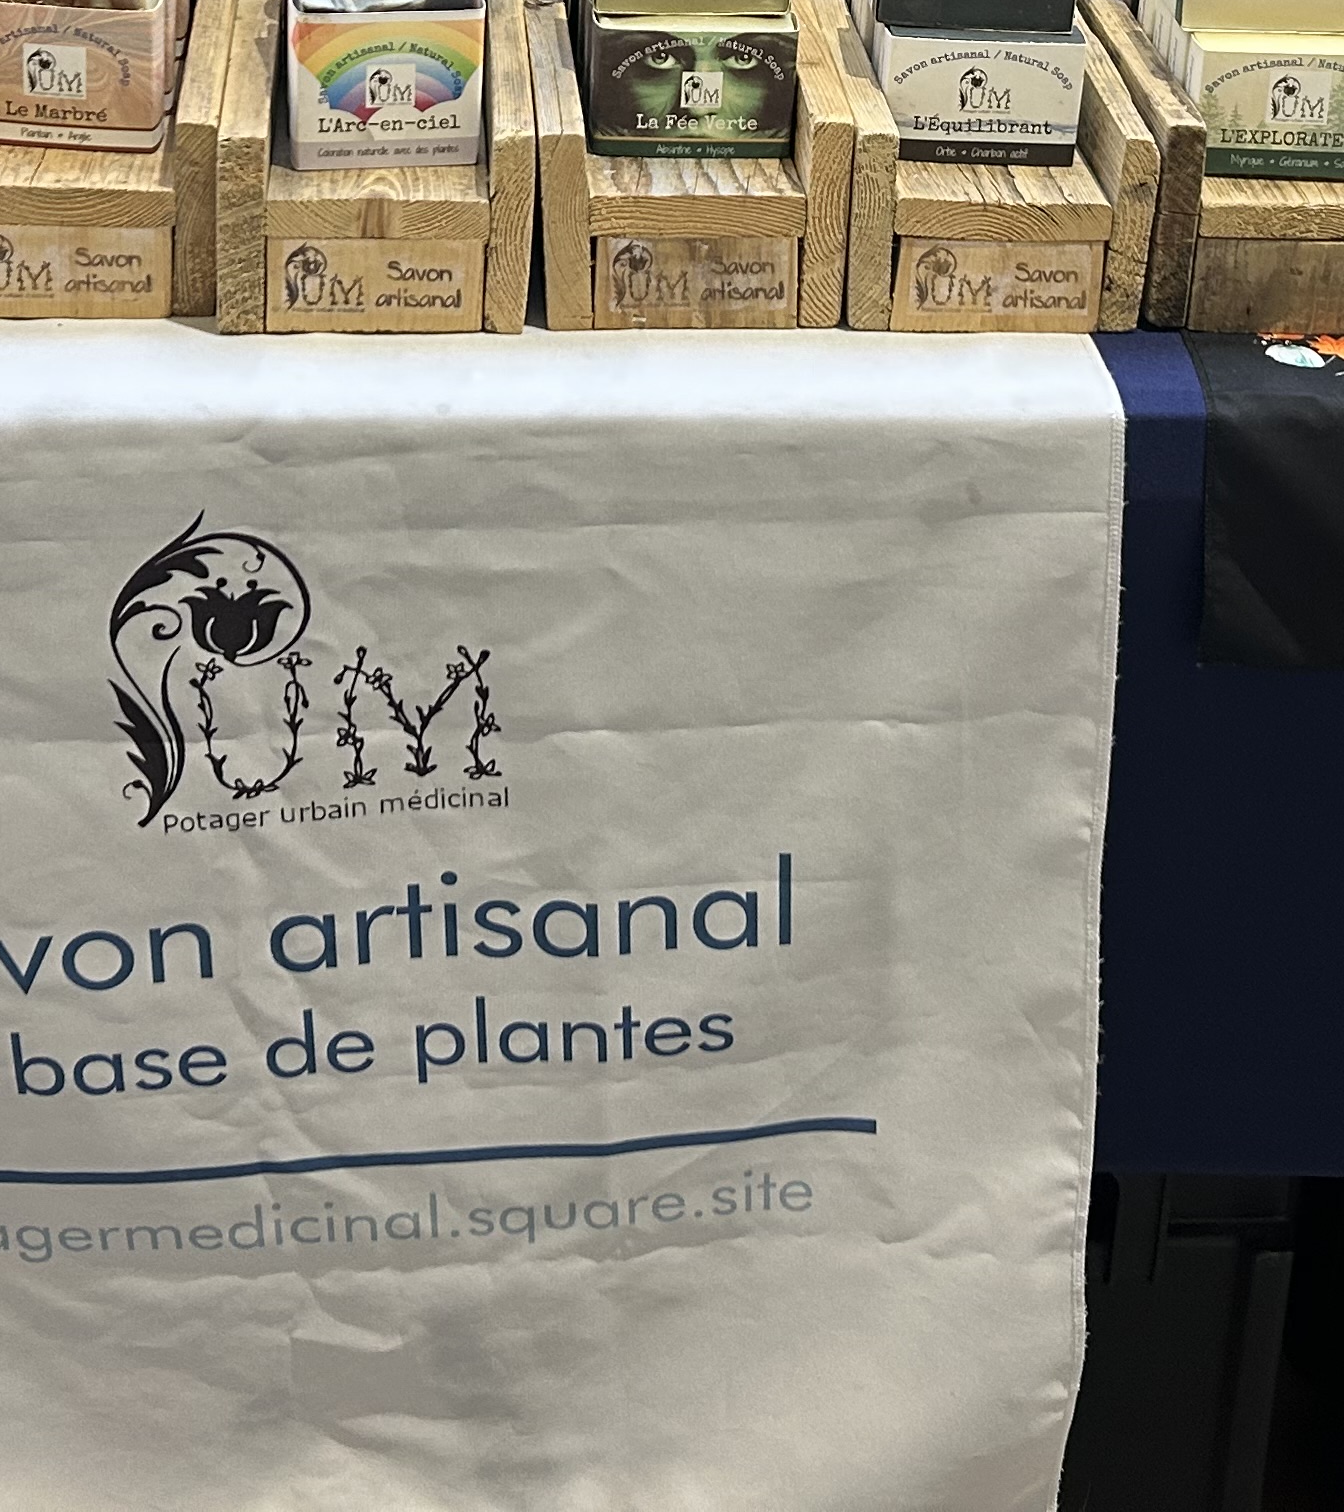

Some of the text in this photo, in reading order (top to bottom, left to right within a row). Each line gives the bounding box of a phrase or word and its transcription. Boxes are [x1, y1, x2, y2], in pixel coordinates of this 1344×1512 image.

[894, 50, 1073, 91] Savon artisanal Natural Soap
[1205, 68, 1241, 94] Savon
[1243, 57, 1305, 74] artisanal
[6, 100, 108, 122] Le Marbré
[636, 113, 758, 131] La Fée Verte
[318, 115, 460, 134] L'Arc-en-ciel
[913, 113, 1053, 135] L'Équilibrant
[75, 246, 143, 268] Savon
[712, 255, 776, 276] Savon
[386, 260, 454, 283] Savon
[1014, 263, 1079, 283] Savon
[64, 274, 153, 293] artisanal
[700, 280, 785, 303] artisanal
[375, 287, 463, 311] artisanal
[1002, 289, 1087, 311] artisanal
[162, 786, 510, 833] Potager urbain médicinal
[267, 854, 793, 973] artisanal
[12, 1032, 227, 1099] base
[267, 1008, 376, 1078] de
[414, 997, 735, 1083] plantes
